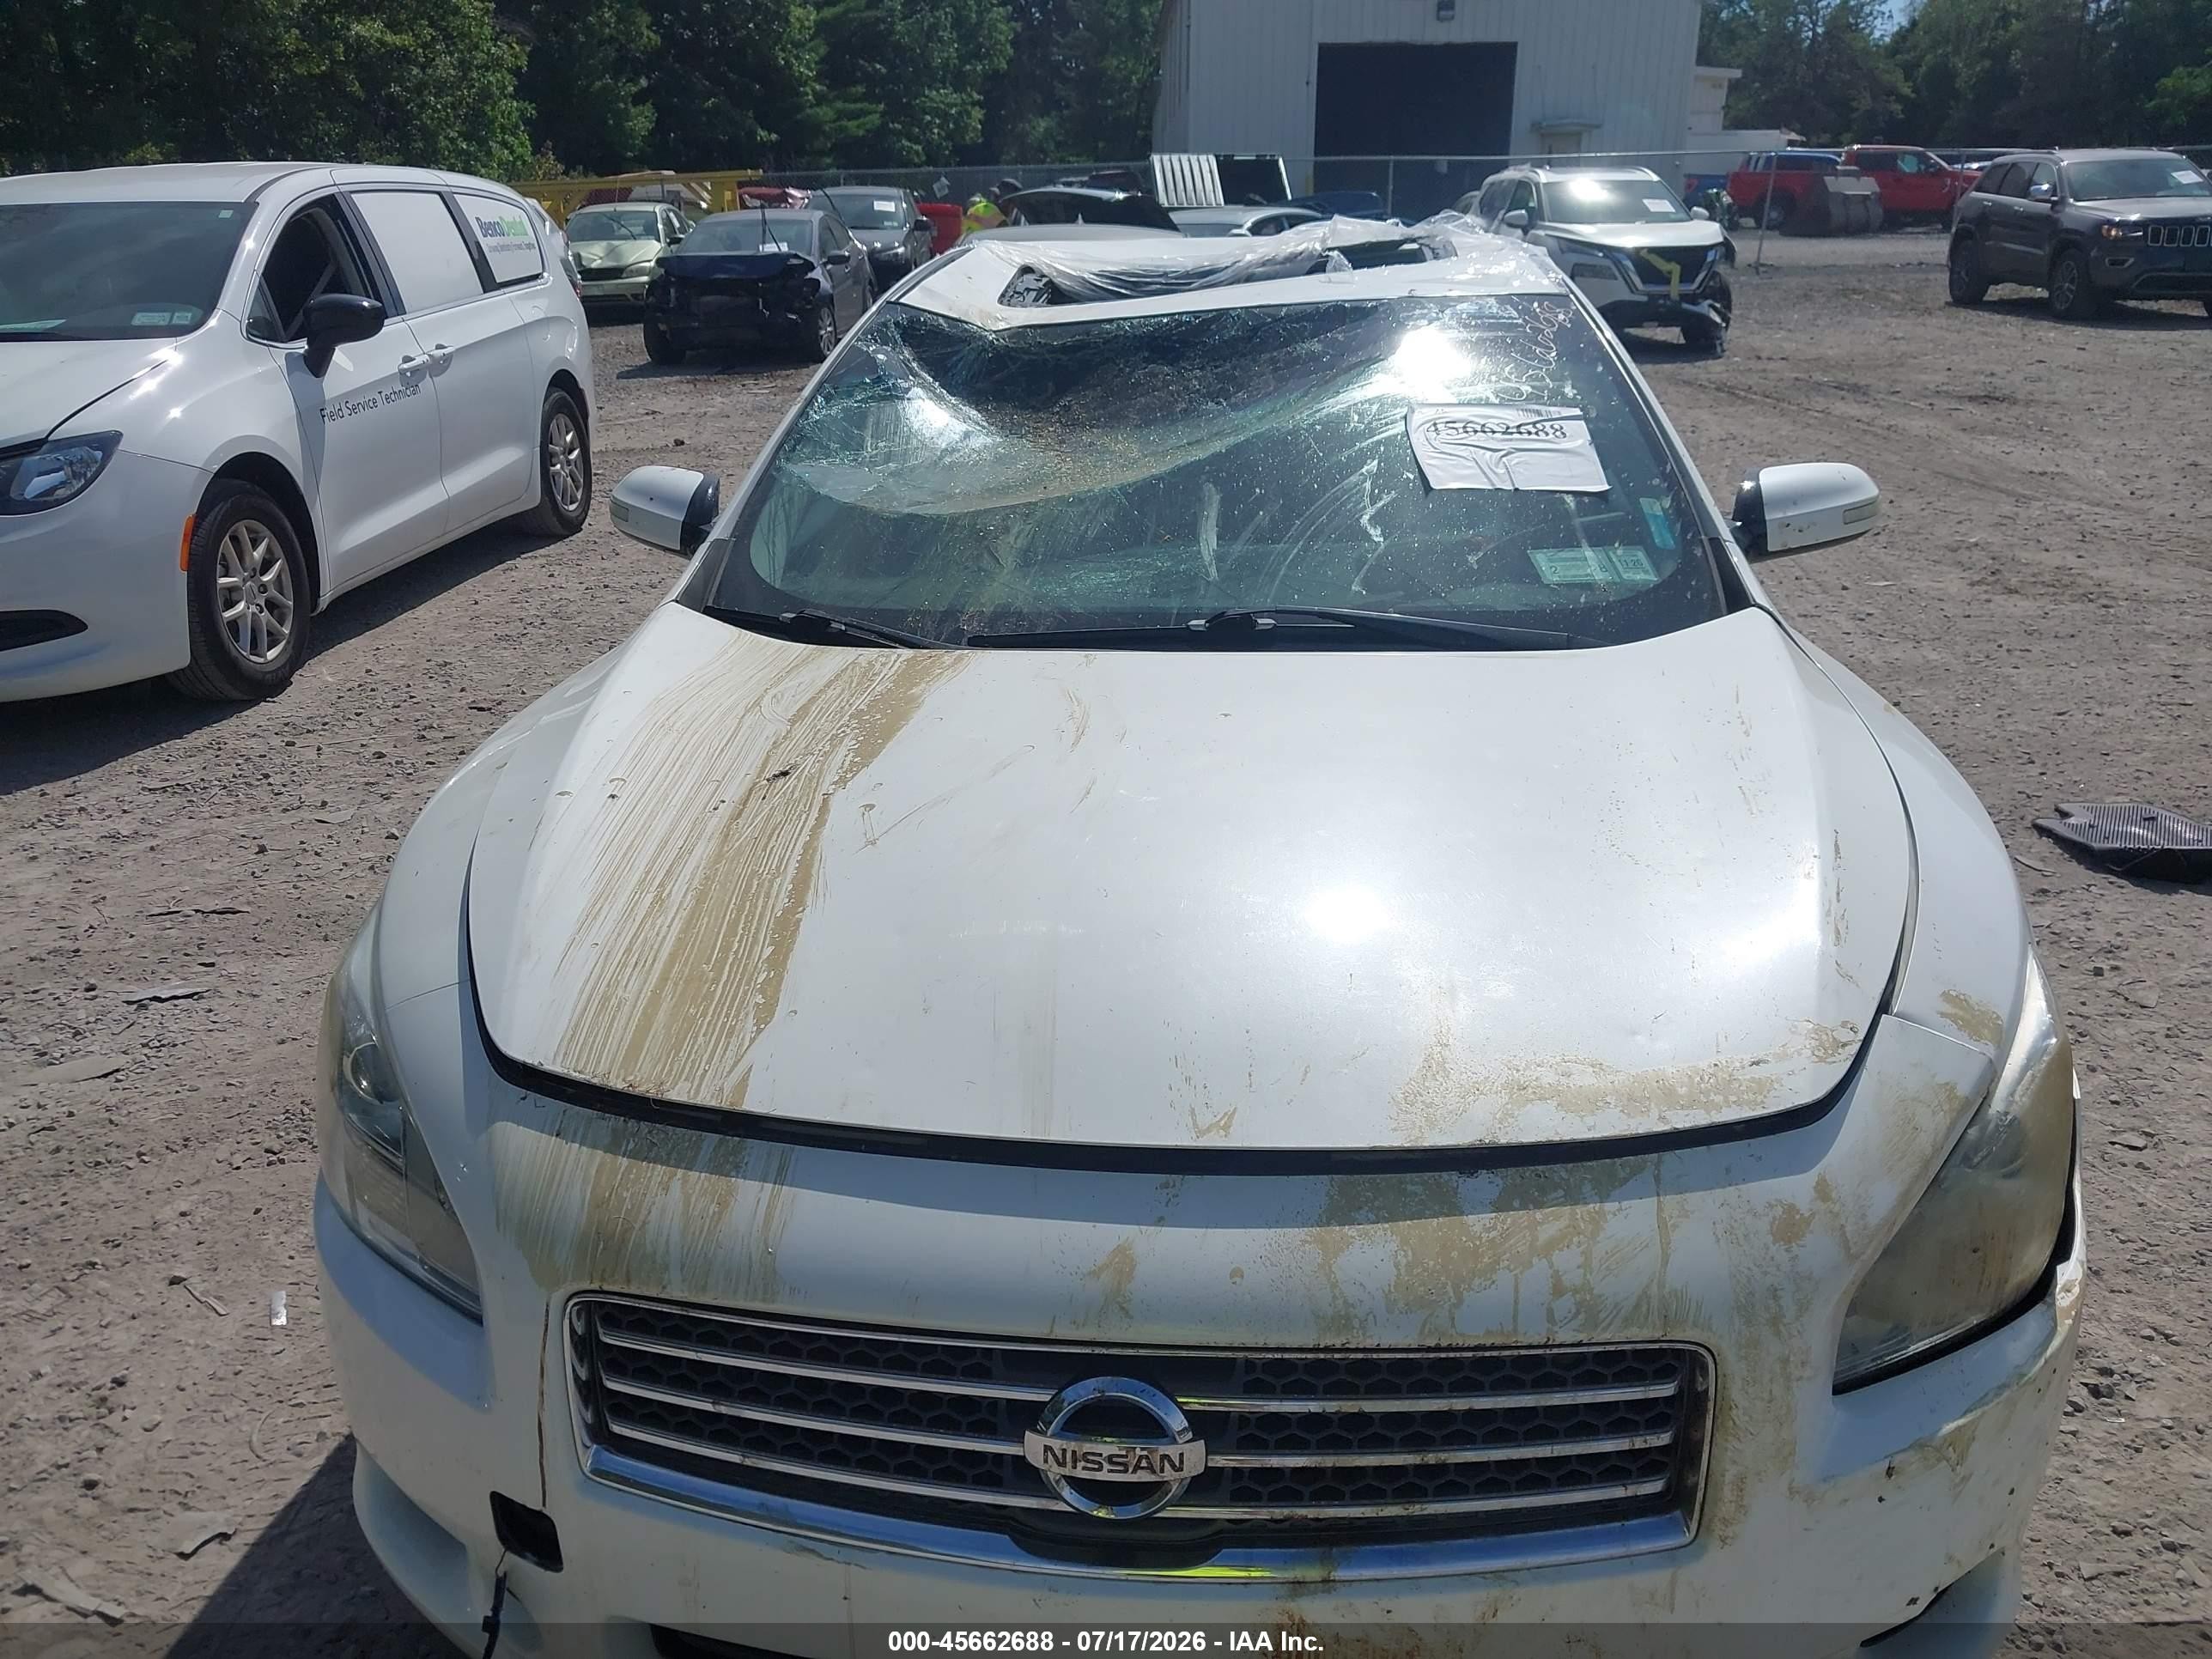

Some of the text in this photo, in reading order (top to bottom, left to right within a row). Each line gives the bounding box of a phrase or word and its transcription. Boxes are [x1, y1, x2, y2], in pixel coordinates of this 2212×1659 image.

[319, 383, 422, 425] Field Service Technician
[1426, 420, 1567, 440] 45662688
[1042, 1444, 1184, 1475] NISSAN
